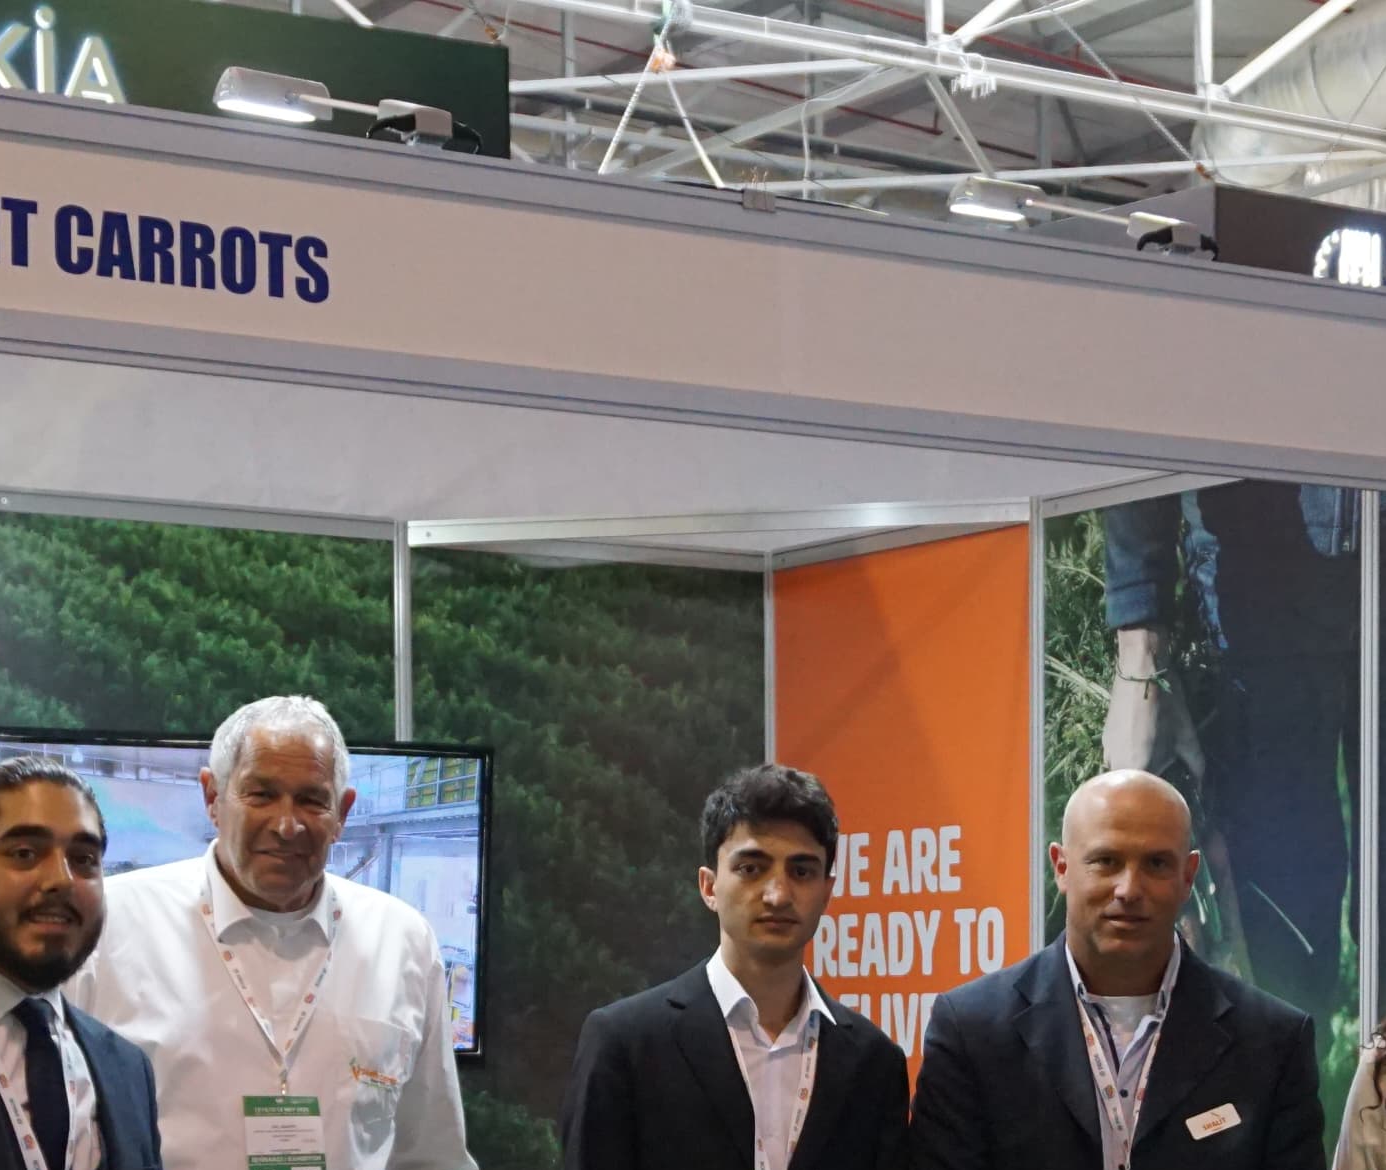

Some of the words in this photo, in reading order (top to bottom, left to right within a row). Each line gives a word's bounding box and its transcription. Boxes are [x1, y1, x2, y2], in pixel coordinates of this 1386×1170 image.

[55, 204, 330, 303] CARROTS
[883, 825, 961, 895] ARE
[813, 911, 941, 977] READY
[954, 907, 1005, 975] TO
